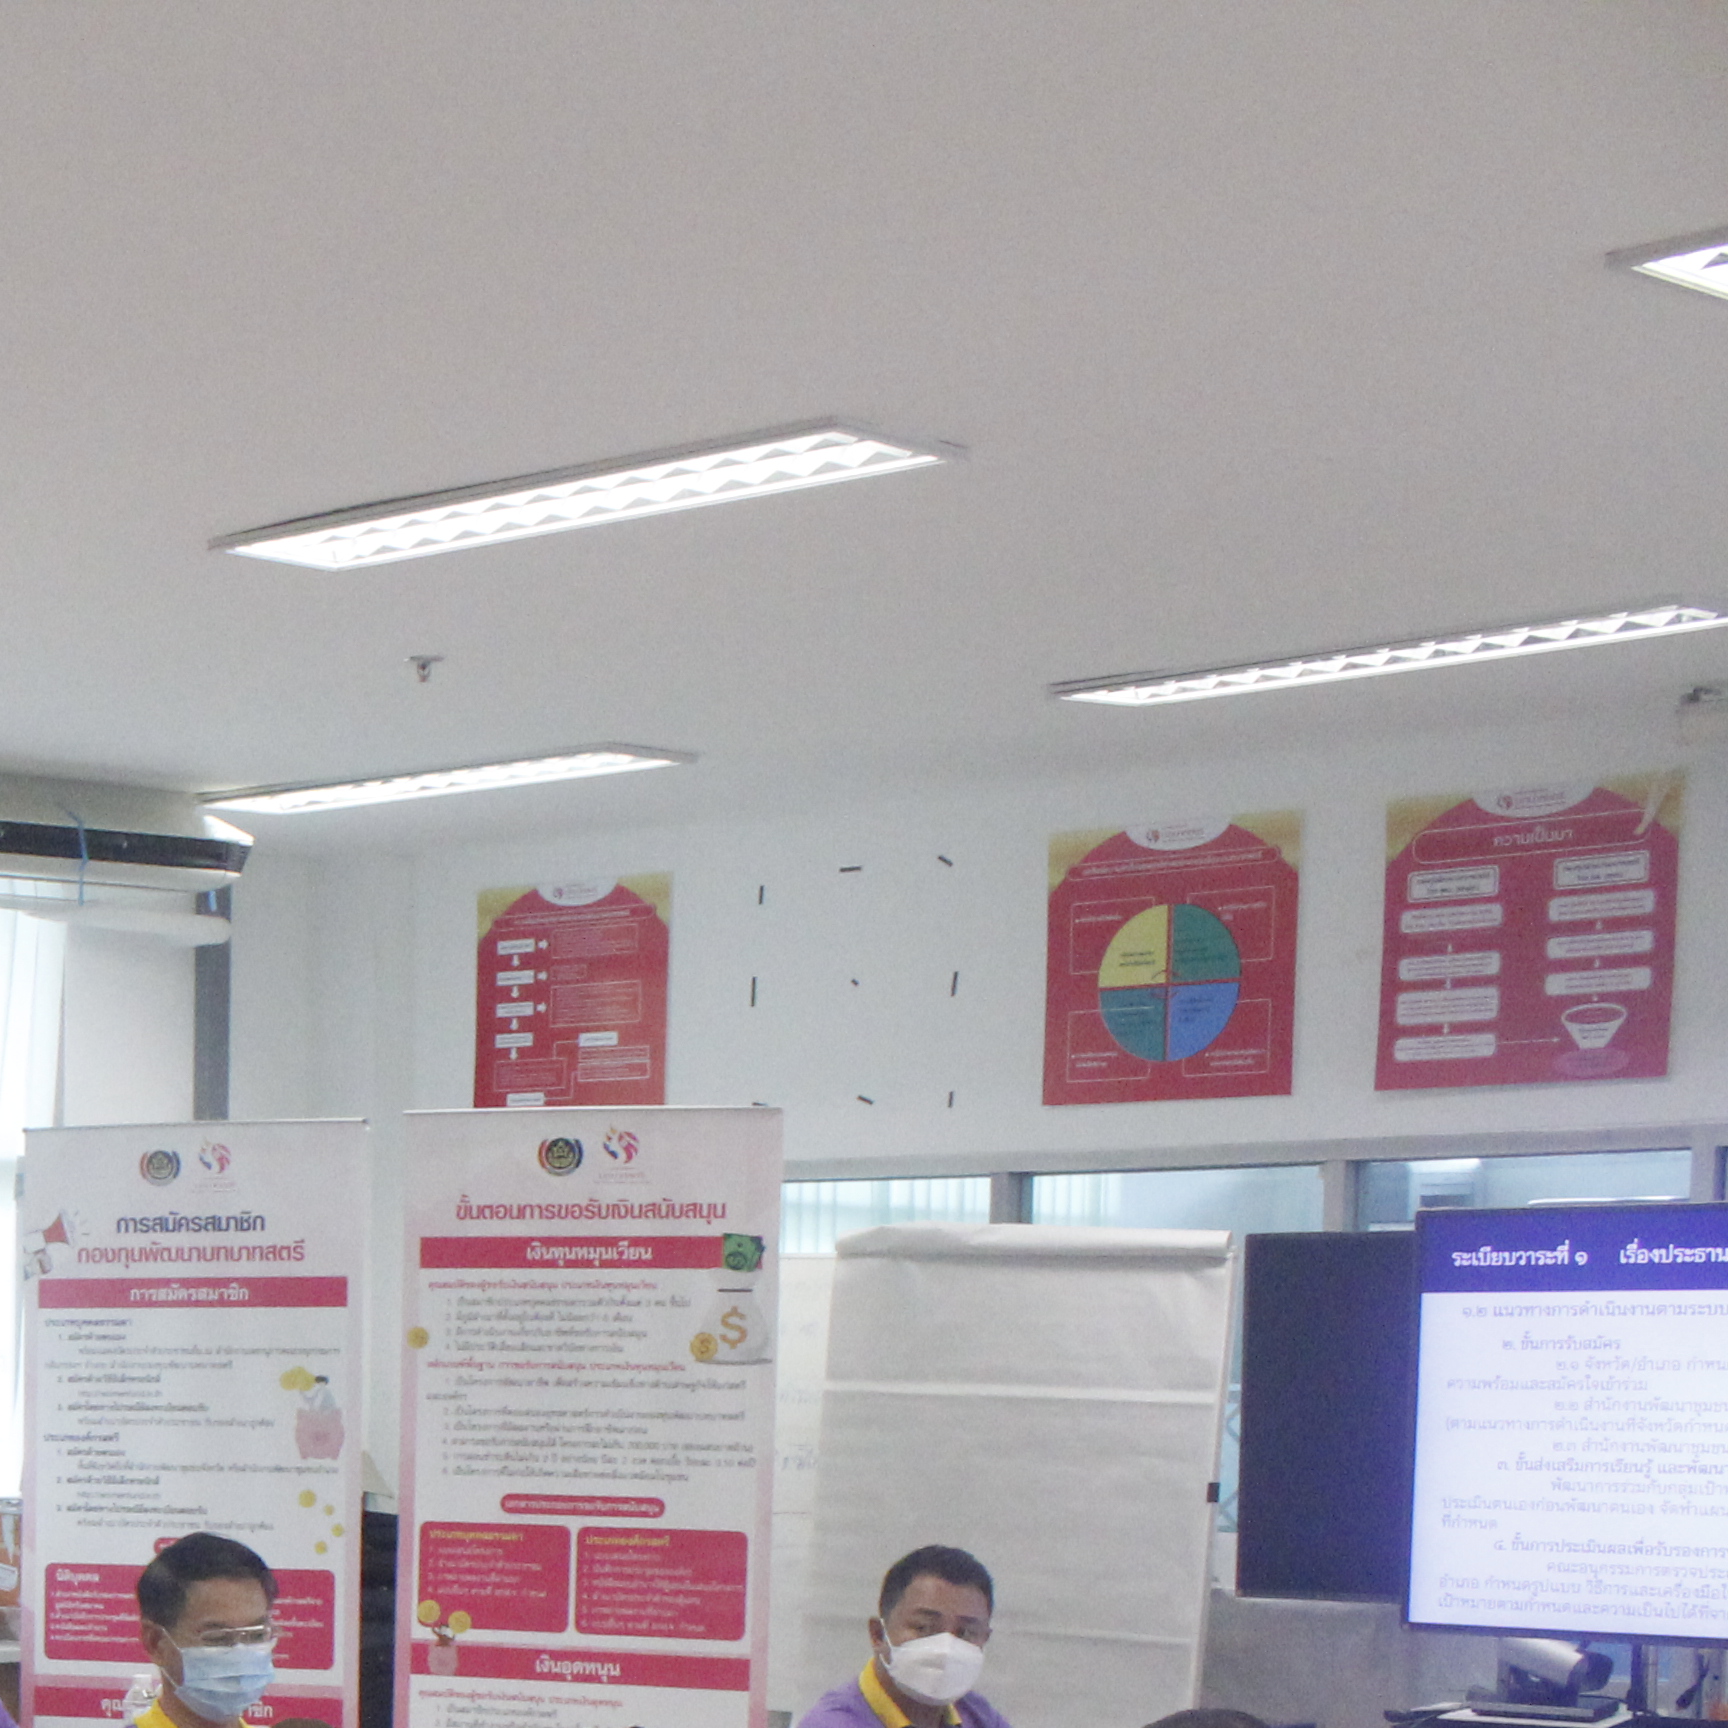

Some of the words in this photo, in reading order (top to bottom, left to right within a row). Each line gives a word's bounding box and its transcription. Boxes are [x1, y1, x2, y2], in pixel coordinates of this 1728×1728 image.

[116, 1209, 265, 1235] การสมัครสมาชิก
[456, 1194, 726, 1225] ขั้นตอนการขอรับเงินสนับสนุน
[77, 1238, 305, 1269] กองทุนพัฒนาบทบาทสตรี
[1451, 1239, 1569, 1267] ระเบียบวาระที่
[1574, 1250, 1588, 1266] ๑
[130, 1282, 249, 1302] การสมัครสมาชิก
[1686, 1356, 1728, 1373] กำหน
[1511, 1532, 1728, 1559] ขั้นการประเมินผลเพื่อรับรองการ
